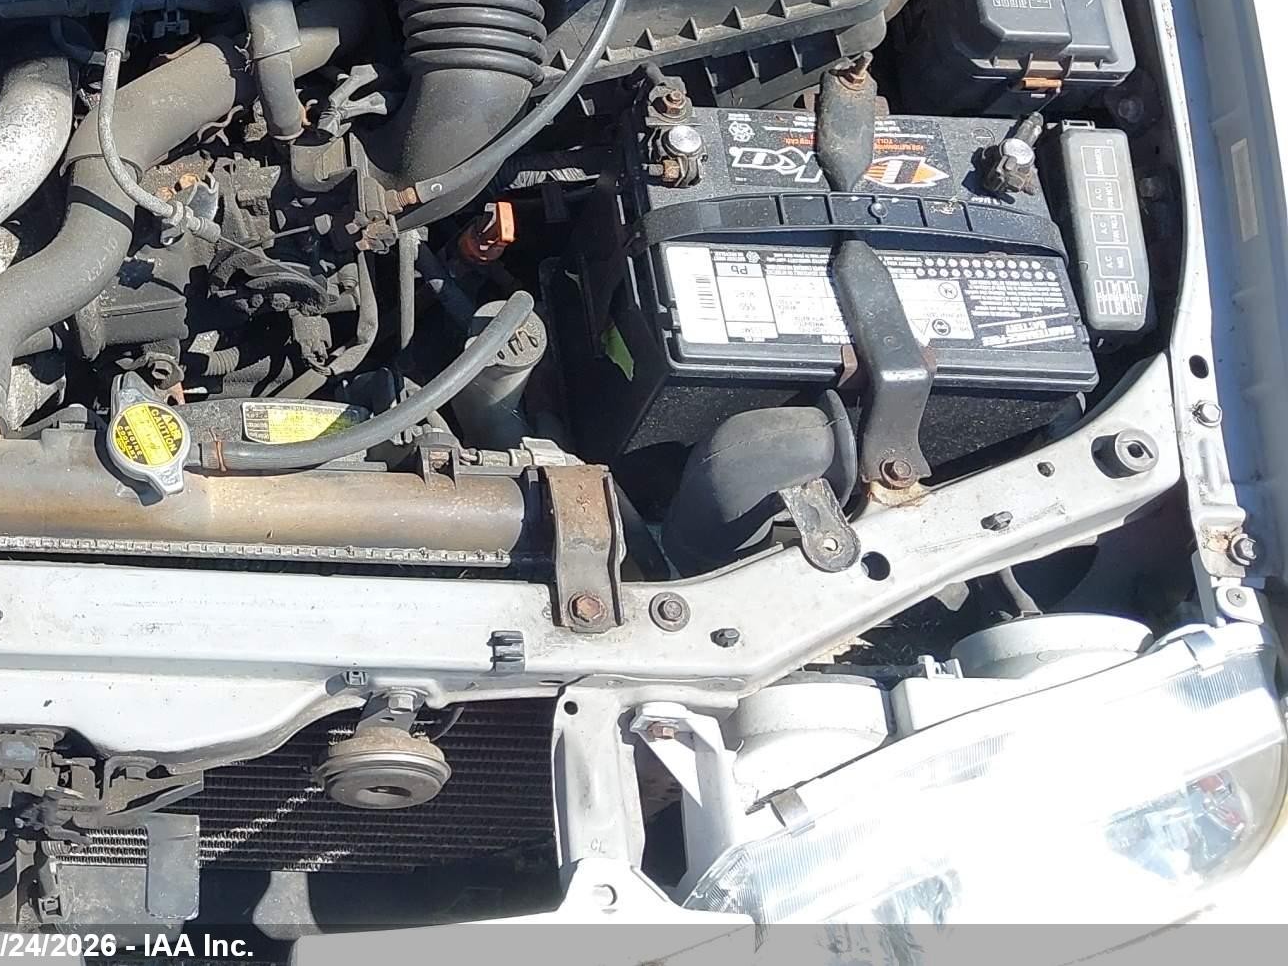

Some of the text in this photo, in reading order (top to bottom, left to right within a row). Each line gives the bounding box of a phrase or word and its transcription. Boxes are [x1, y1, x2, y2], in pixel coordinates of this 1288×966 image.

[731, 265, 748, 275] Pb
[117, 425, 139, 460] COOLANT
[124, 425, 143, 457] ENGINE
[151, 408, 178, 452] CAUTION
